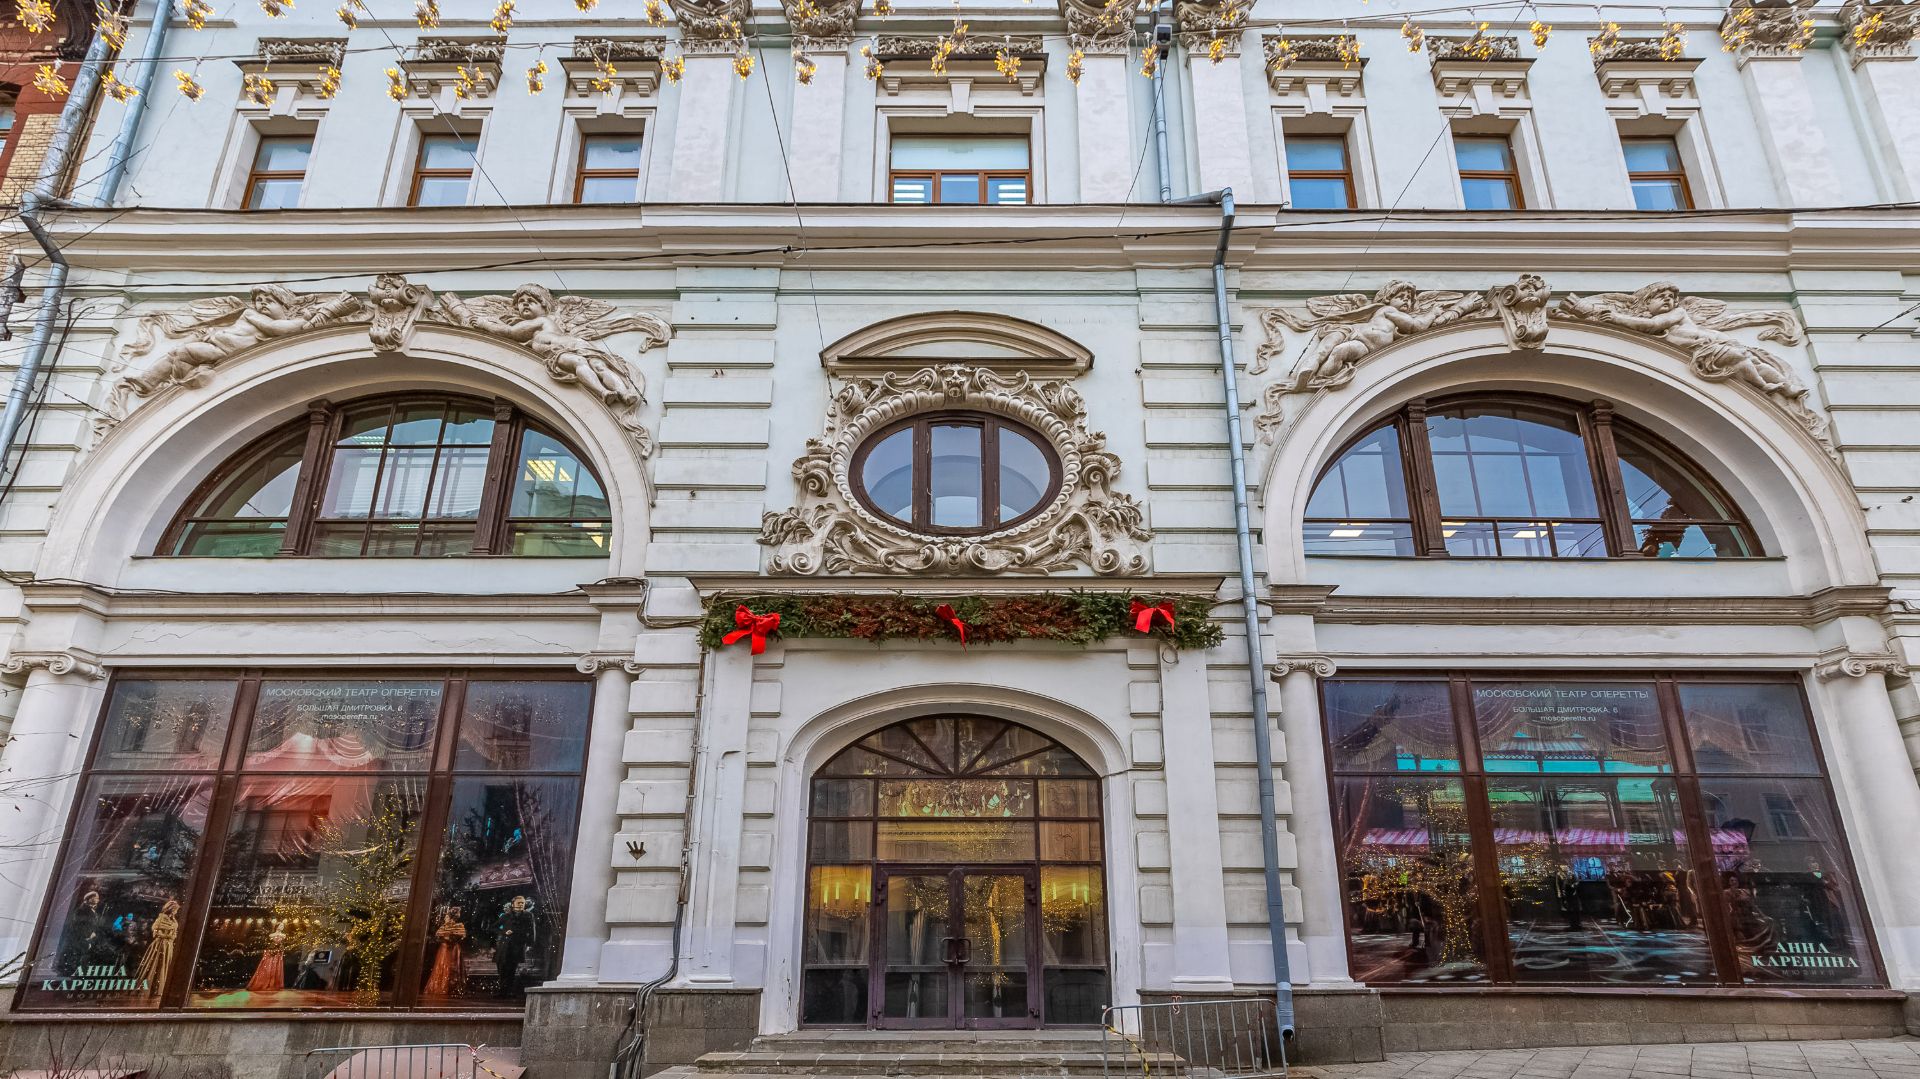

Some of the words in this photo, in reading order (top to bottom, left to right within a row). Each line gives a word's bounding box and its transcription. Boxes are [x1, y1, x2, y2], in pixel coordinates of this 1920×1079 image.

[266, 687, 342, 696] МОСКОВСКИЙ
[345, 688, 378, 696] ТЕАТР
[381, 688, 440, 696] ОПЕРЕТТЫ
[1476, 689, 1552, 698] МОСКОВСКИЙ
[1556, 690, 1588, 698] ТЕАТР
[1590, 690, 1648, 698] ОПЕРЕТТЫ
[1775, 942, 1830, 954] АННА
[1751, 956, 1859, 968] КАРЕНИНА
[72, 965, 128, 977] АННА
[41, 979, 149, 991] КАРЕНИНА
